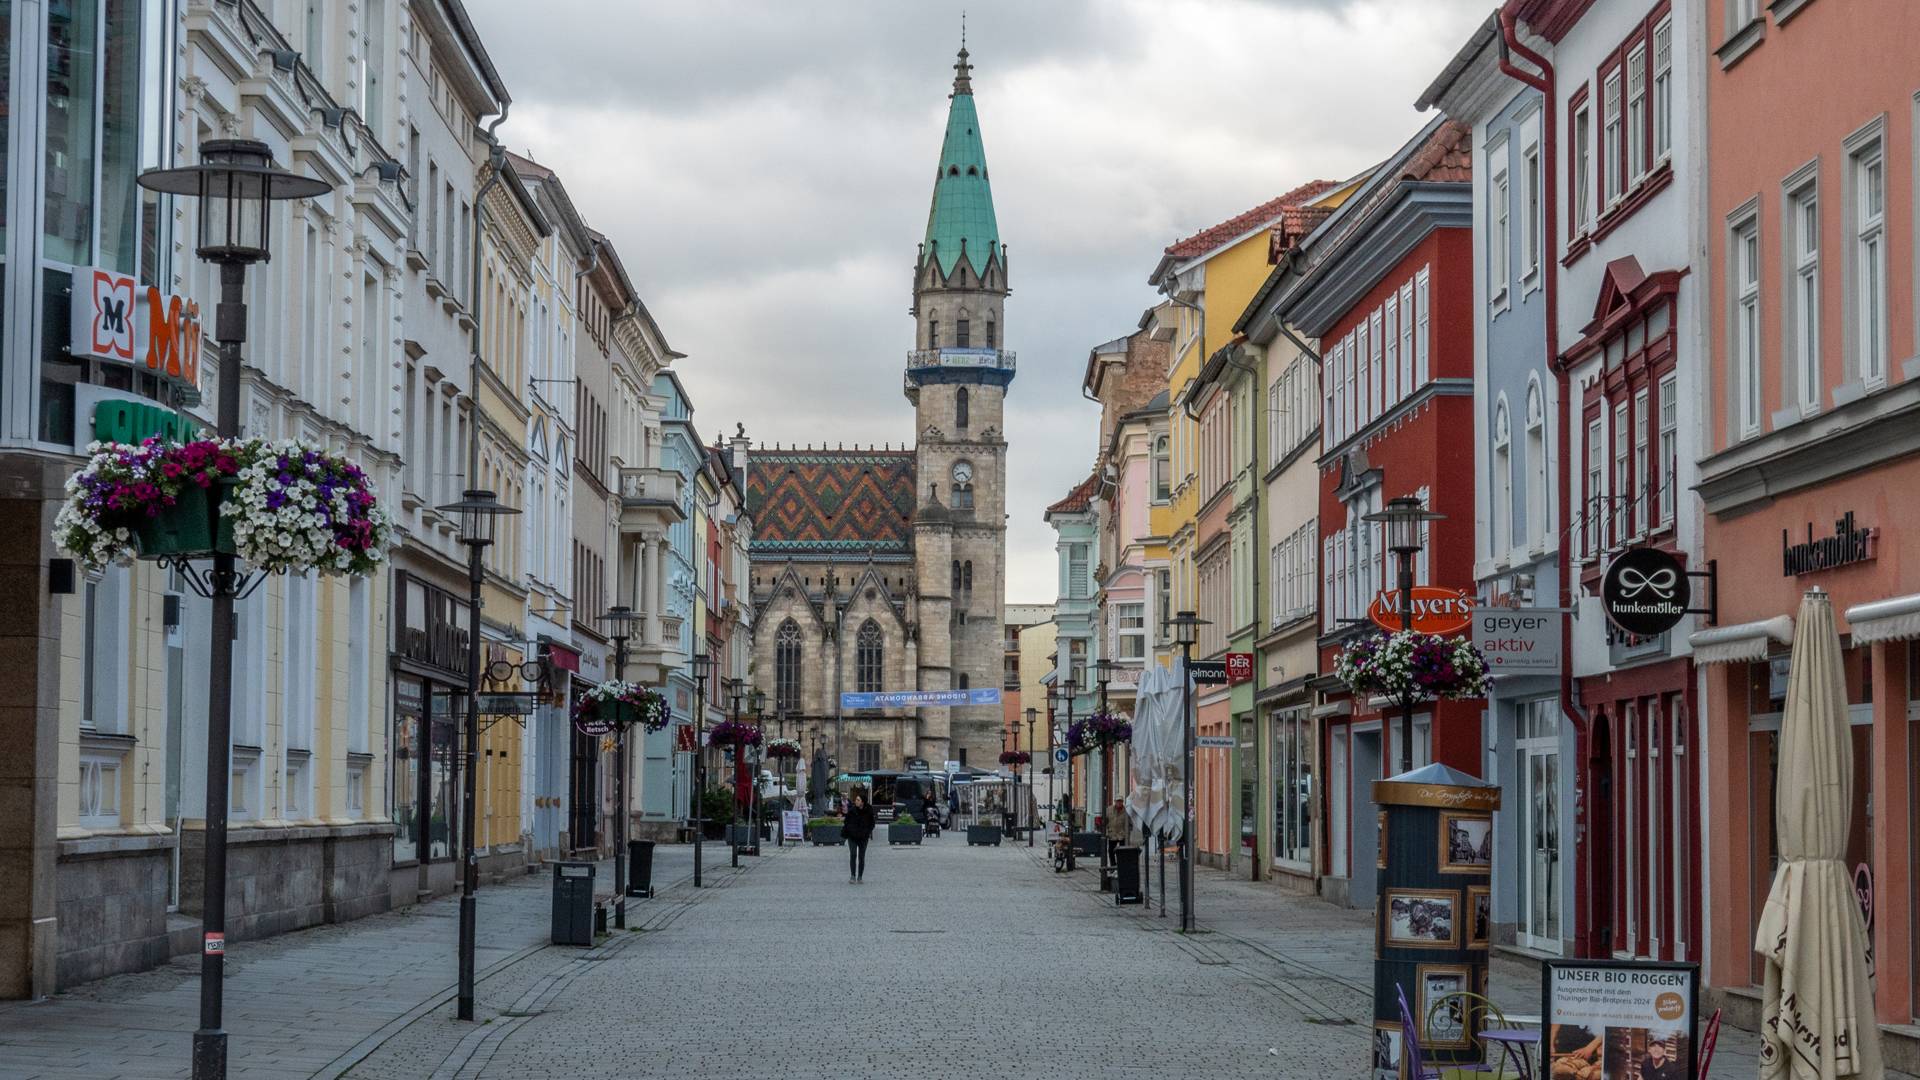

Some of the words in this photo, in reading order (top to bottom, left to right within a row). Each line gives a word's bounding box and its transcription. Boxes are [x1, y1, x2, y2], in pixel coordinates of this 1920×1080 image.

[103, 296, 124, 334] M
[1782, 510, 1876, 577] hunkemöller
[1612, 600, 1684, 615] hunkemöller
[1484, 617, 1547, 633] geyer
[1484, 636, 1535, 652] aktiv
[1229, 657, 1250, 668] DER
[1230, 668, 1250, 676] TOUR
[1557, 969, 1600, 982] UNSER
[1604, 972, 1627, 984] BIO
[1631, 973, 1684, 986] ROGGEN
[1556, 986, 1603, 995] Ausgezeichnet
[1556, 994, 1590, 1004] Thüringer
[1590, 996, 1632, 1006] Bio-Brotpreis
